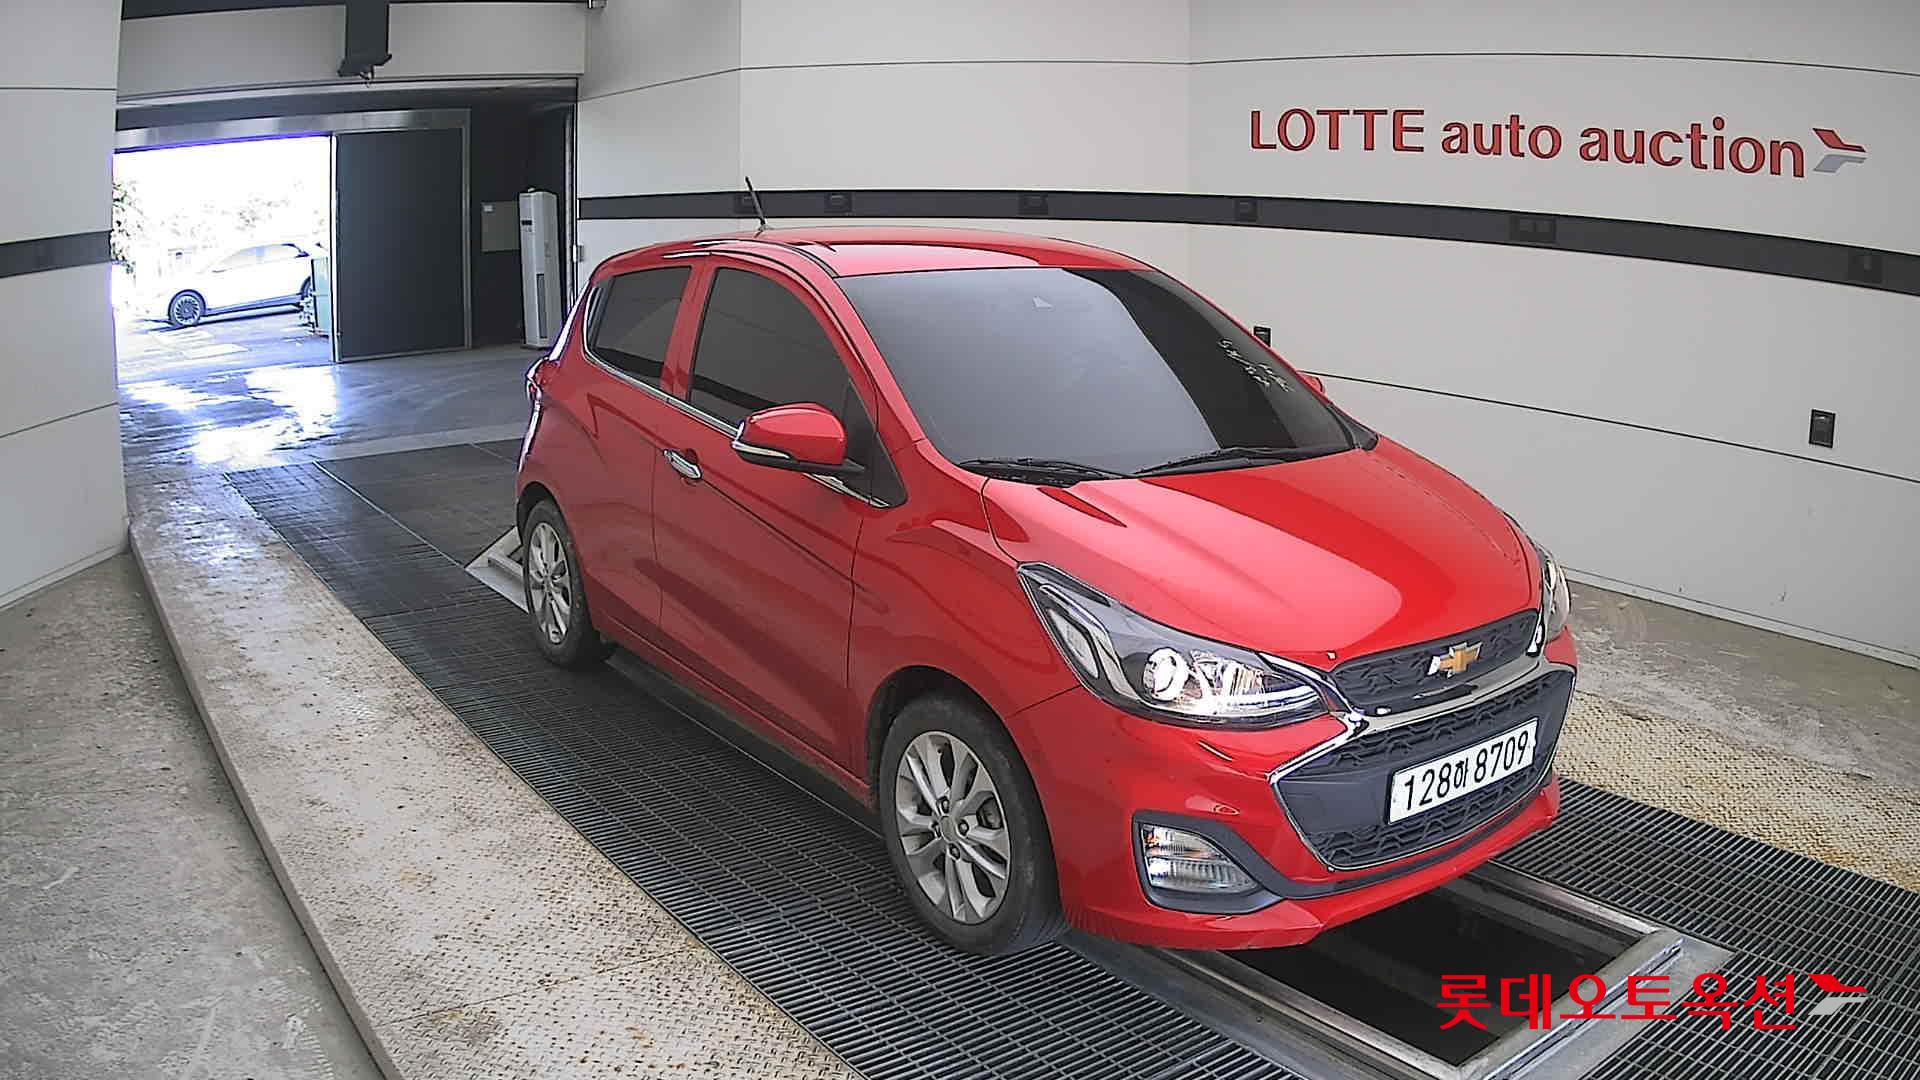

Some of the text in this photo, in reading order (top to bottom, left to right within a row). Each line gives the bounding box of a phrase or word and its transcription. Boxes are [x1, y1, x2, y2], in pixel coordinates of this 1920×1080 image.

[1250, 109, 1805, 178] LOTTE auto auction
